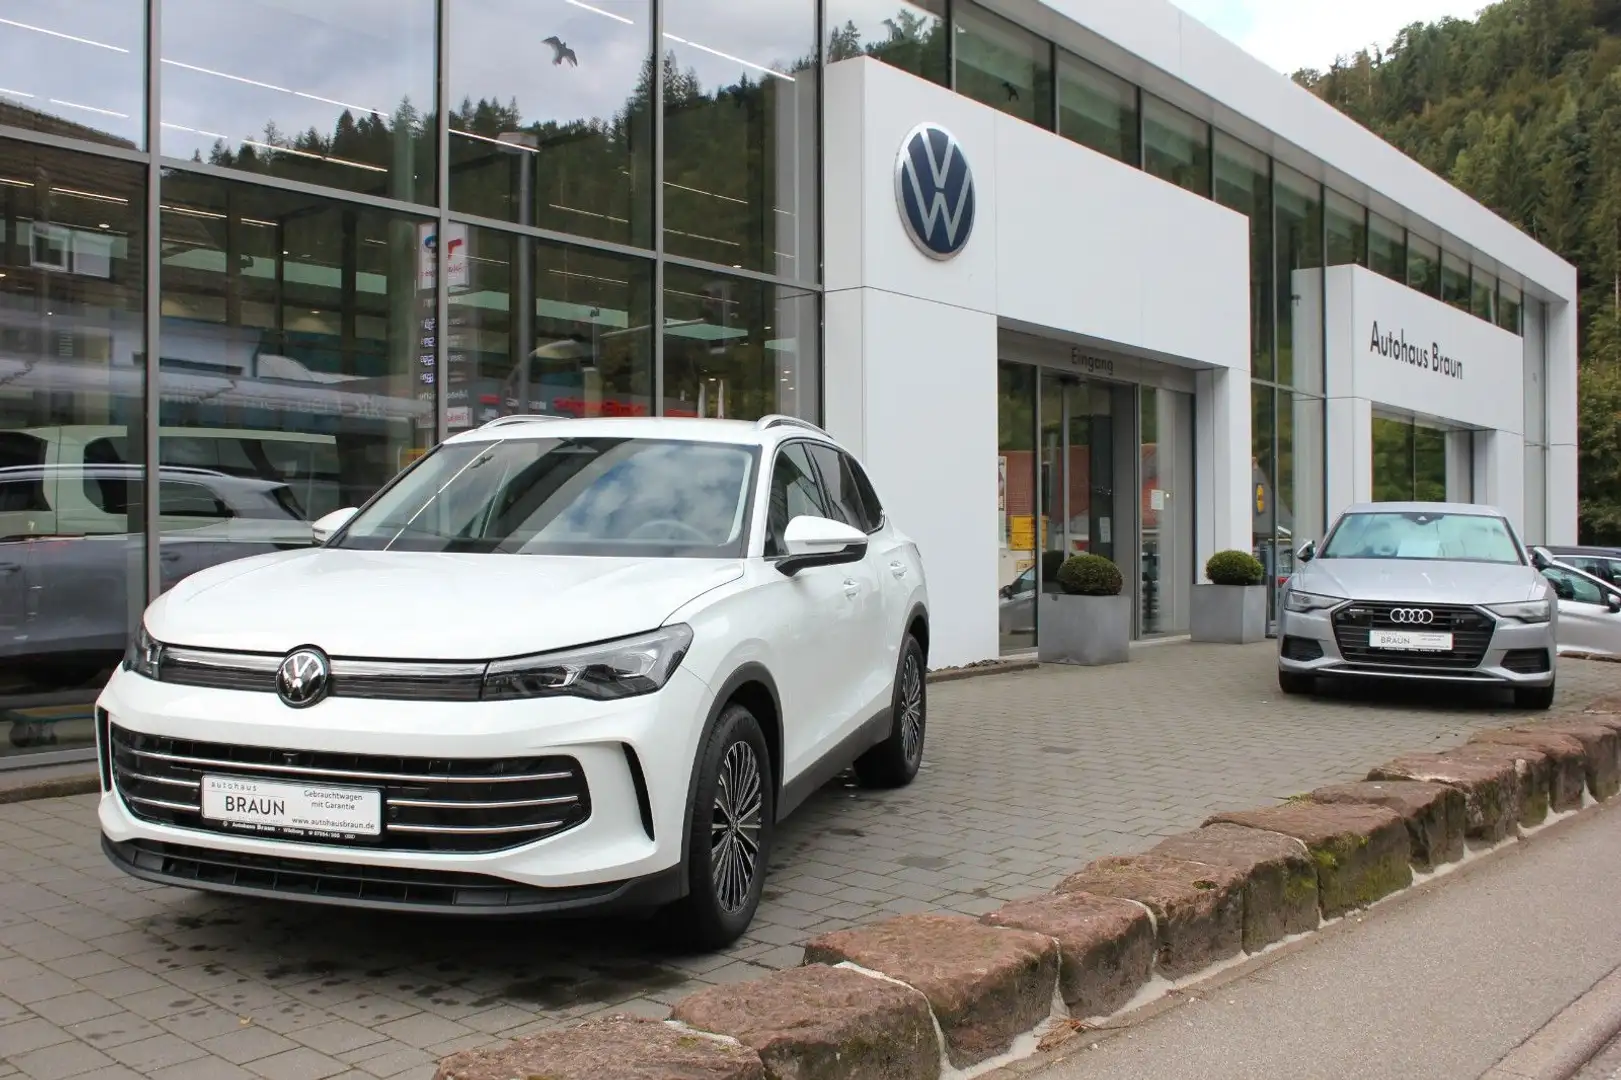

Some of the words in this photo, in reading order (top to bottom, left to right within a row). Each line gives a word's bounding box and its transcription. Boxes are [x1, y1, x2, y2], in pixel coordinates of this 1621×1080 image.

[1370, 320, 1428, 368] Autohaus
[1432, 342, 1463, 380] Braun
[1070, 346, 1114, 376] Eingang
[1380, 636, 1410, 645] BRAUN
[211, 781, 258, 791] autohaus
[303, 789, 363, 802] Gebrauchtwagen
[225, 795, 286, 816] BRAUN
[311, 801, 324, 809] mit
[325, 802, 355, 811] Garantie
[291, 817, 376, 830] www.autohausbraun.de
